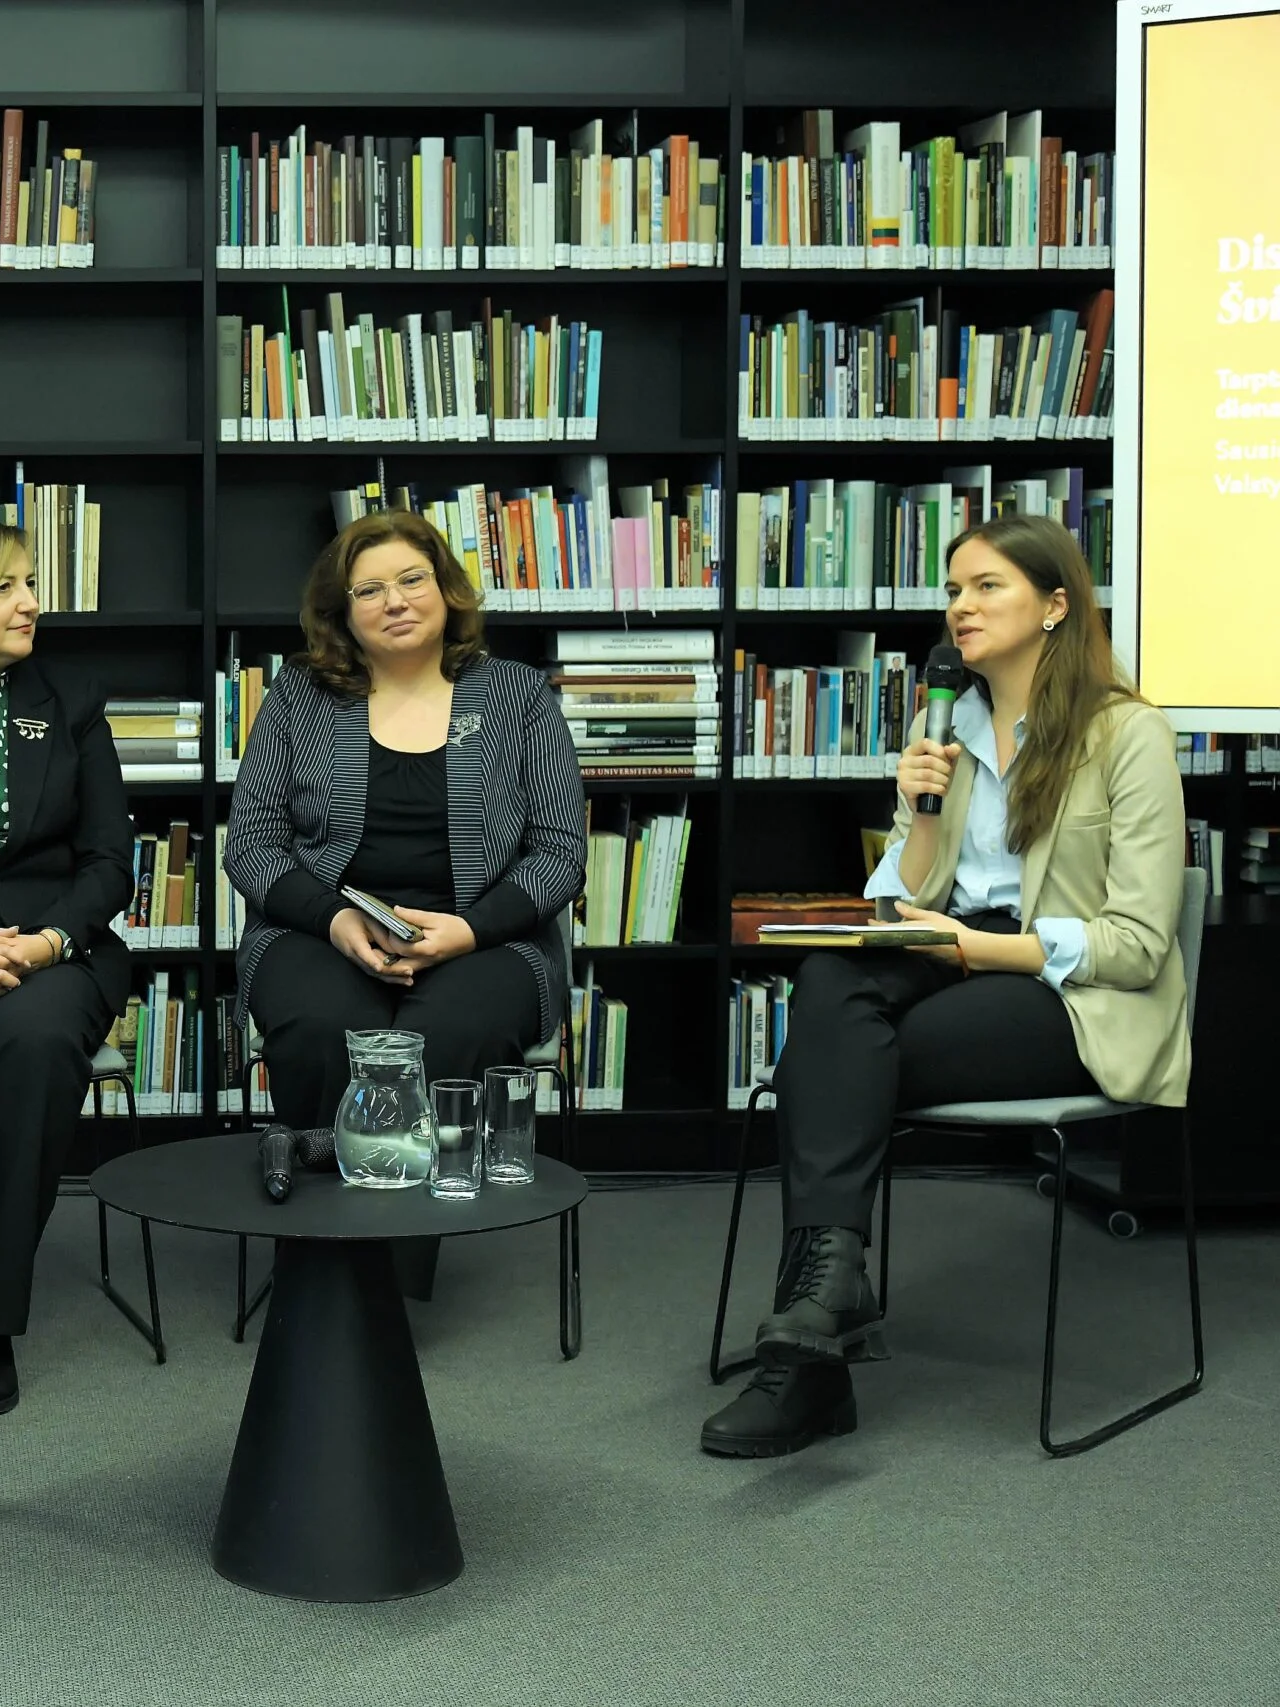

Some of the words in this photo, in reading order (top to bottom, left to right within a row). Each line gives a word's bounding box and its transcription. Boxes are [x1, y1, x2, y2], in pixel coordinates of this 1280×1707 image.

[1141, 4, 1173, 15] SMART
[1216, 439, 1280, 459] Sausi
[478, 507, 489, 535] GRAND
[481, 537, 492, 570] FAILURE
[580, 768, 595, 776] AUS
[597, 767, 662, 776] UNIVERSITETAS
